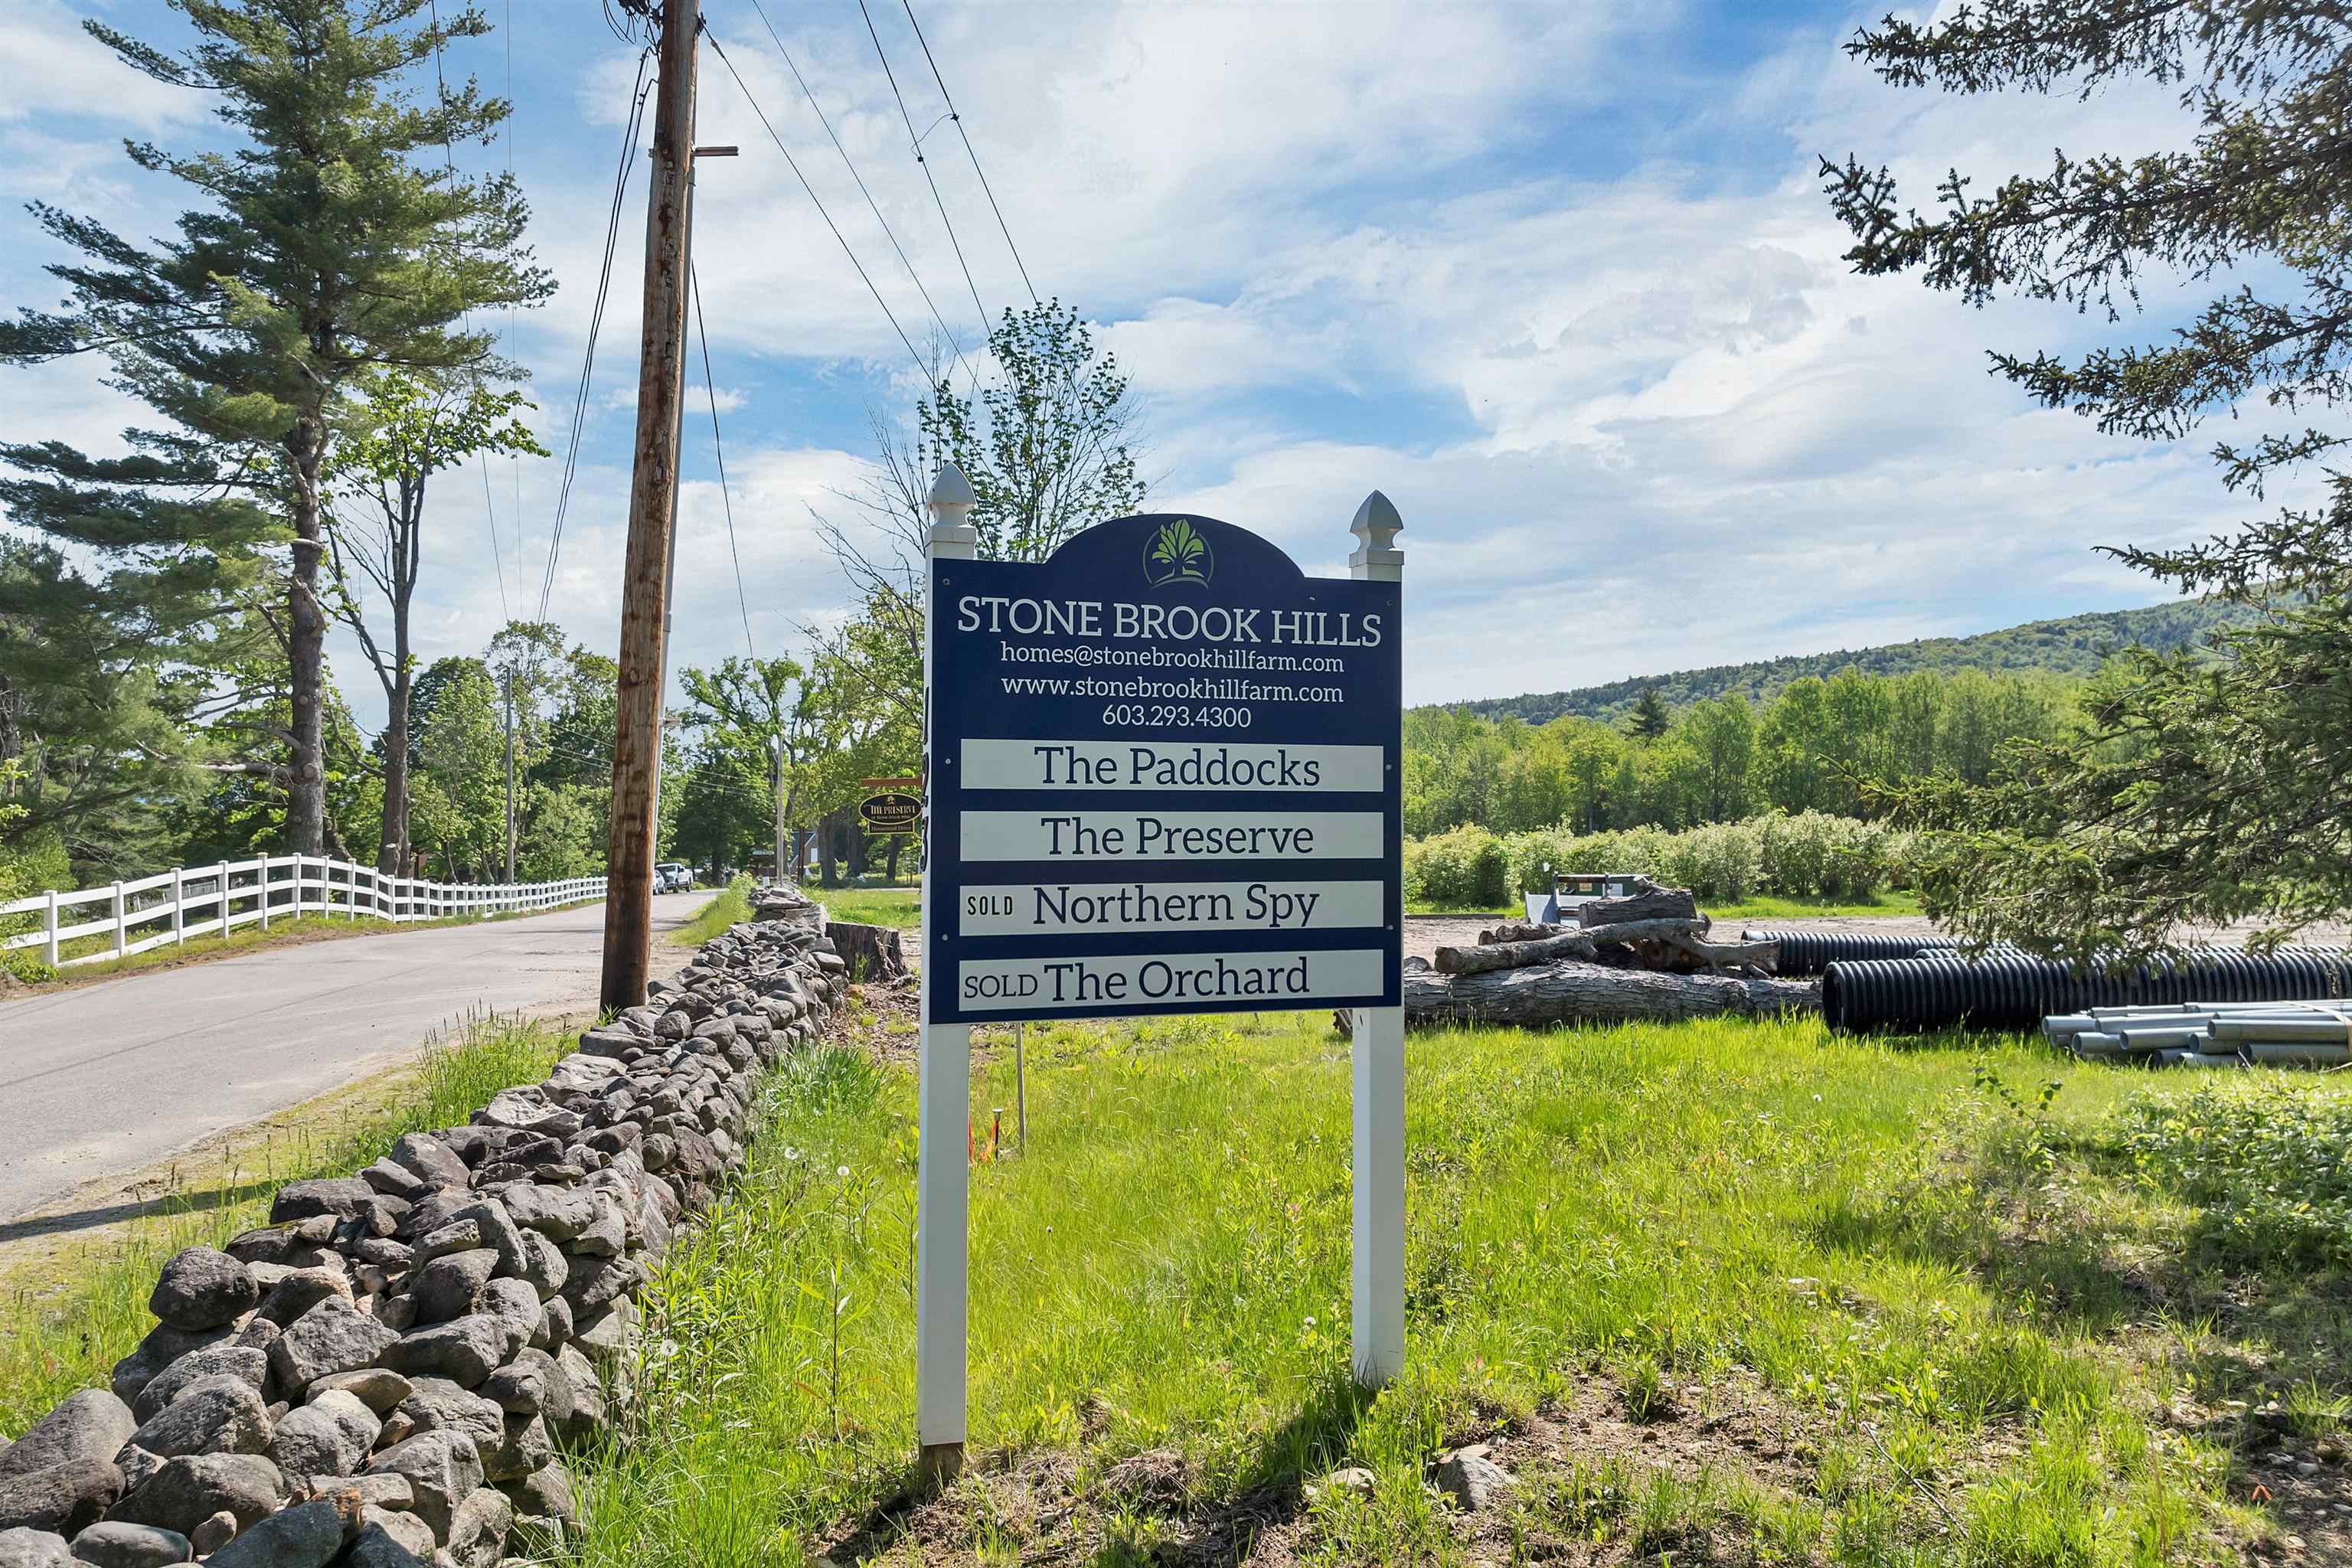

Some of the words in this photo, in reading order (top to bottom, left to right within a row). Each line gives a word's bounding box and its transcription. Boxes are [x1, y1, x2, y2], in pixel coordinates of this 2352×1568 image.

[957, 596, 1102, 637] STONE
[1113, 603, 1261, 642] BROOK
[1271, 609, 1381, 647] HILLS
[1000, 642, 1345, 674] homes@stonebrookhillfarm.com
[1001, 676, 1344, 703] www.stonebrookhillfarm.com
[1102, 704, 1252, 728] 603.293.4300
[1034, 746, 1118, 785] The
[1129, 747, 1320, 786] Paddocks
[1040, 816, 1124, 855] The
[1135, 818, 1314, 854] Preserve
[967, 896, 1014, 916] SOLD
[1033, 884, 1234, 925] Northern
[1246, 884, 1320, 927] Spy
[964, 974, 1038, 999] SOLD
[1044, 962, 1127, 1002] The
[1138, 957, 1310, 998] Orchard
